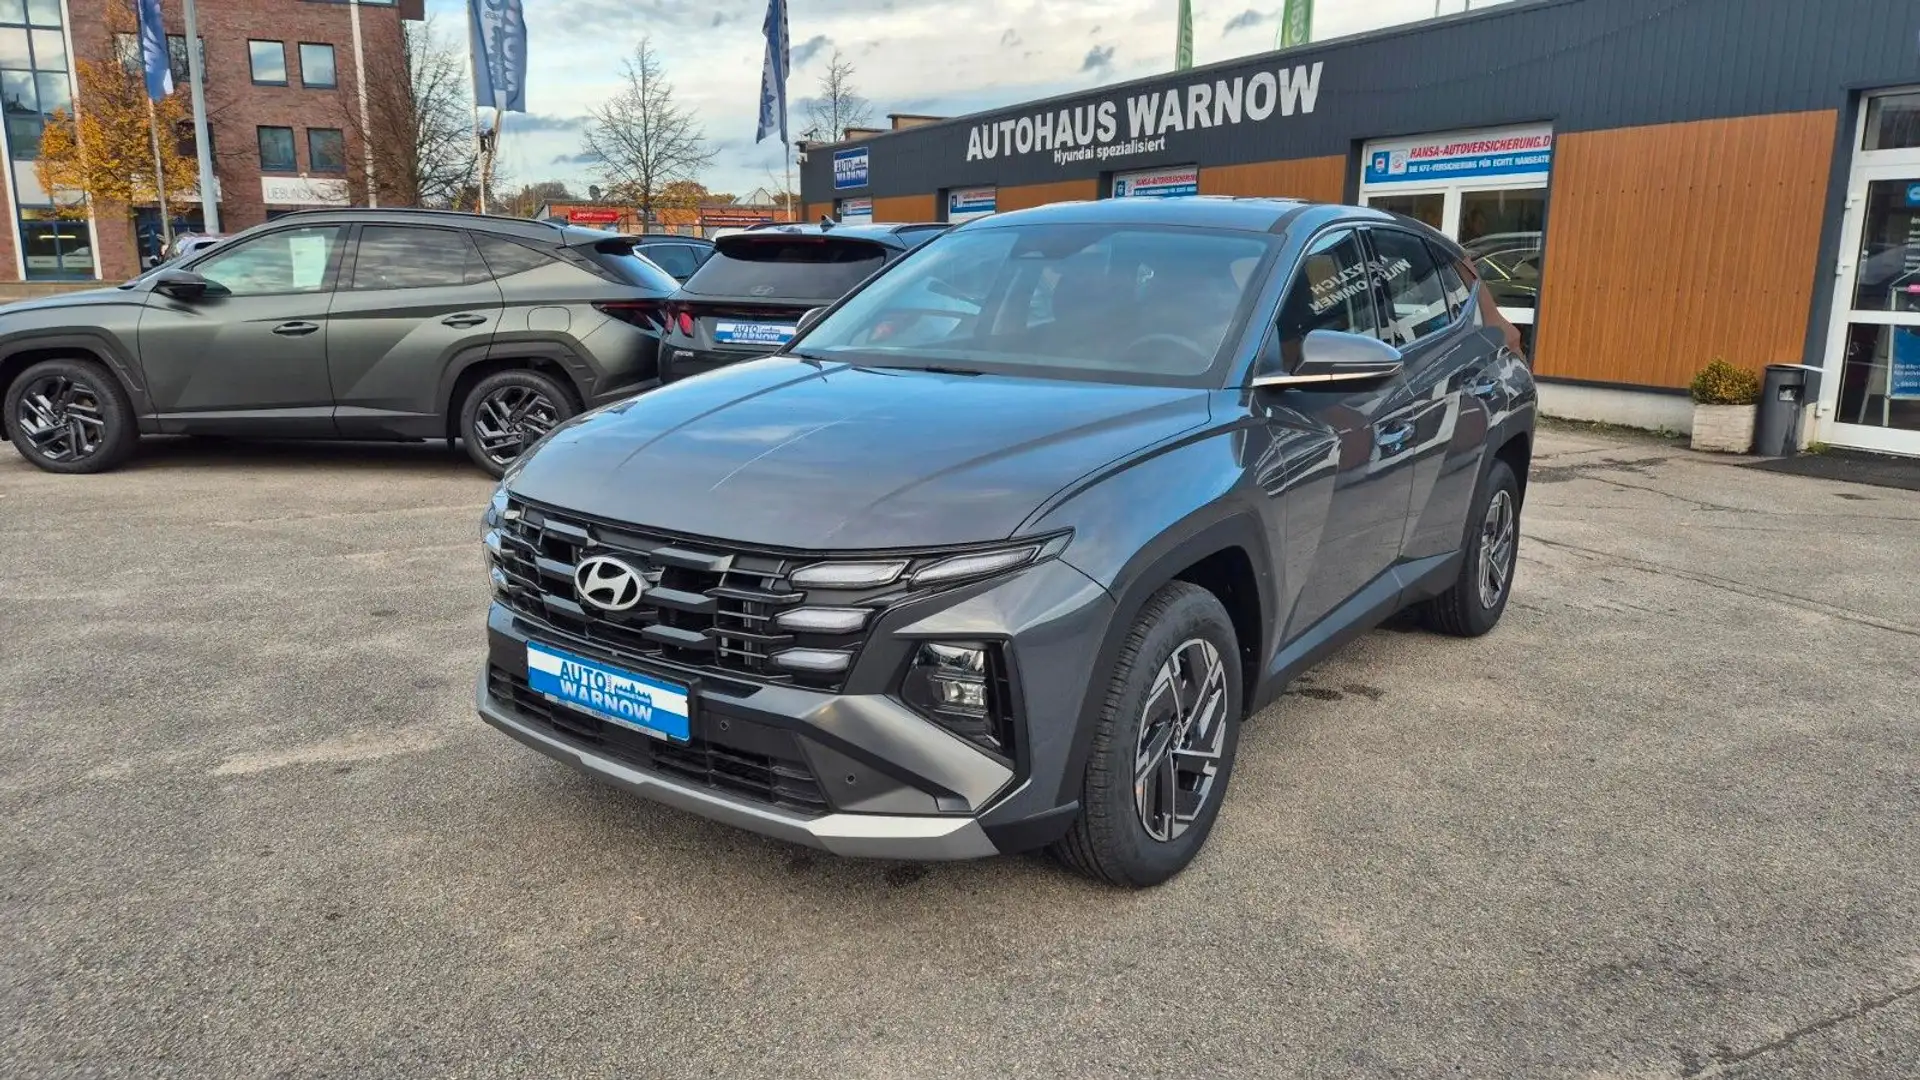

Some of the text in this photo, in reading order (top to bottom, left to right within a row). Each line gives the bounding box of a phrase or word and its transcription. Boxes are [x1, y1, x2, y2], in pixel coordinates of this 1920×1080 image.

[966, 62, 1324, 161] AUTOHAUS WARNOW
[1054, 135, 1166, 166] Hyundai spezialisiert
[732, 332, 780, 341] WARNOW
[733, 324, 759, 334] AUTO
[560, 661, 606, 690] AUTO
[560, 679, 653, 722] WARNOW
